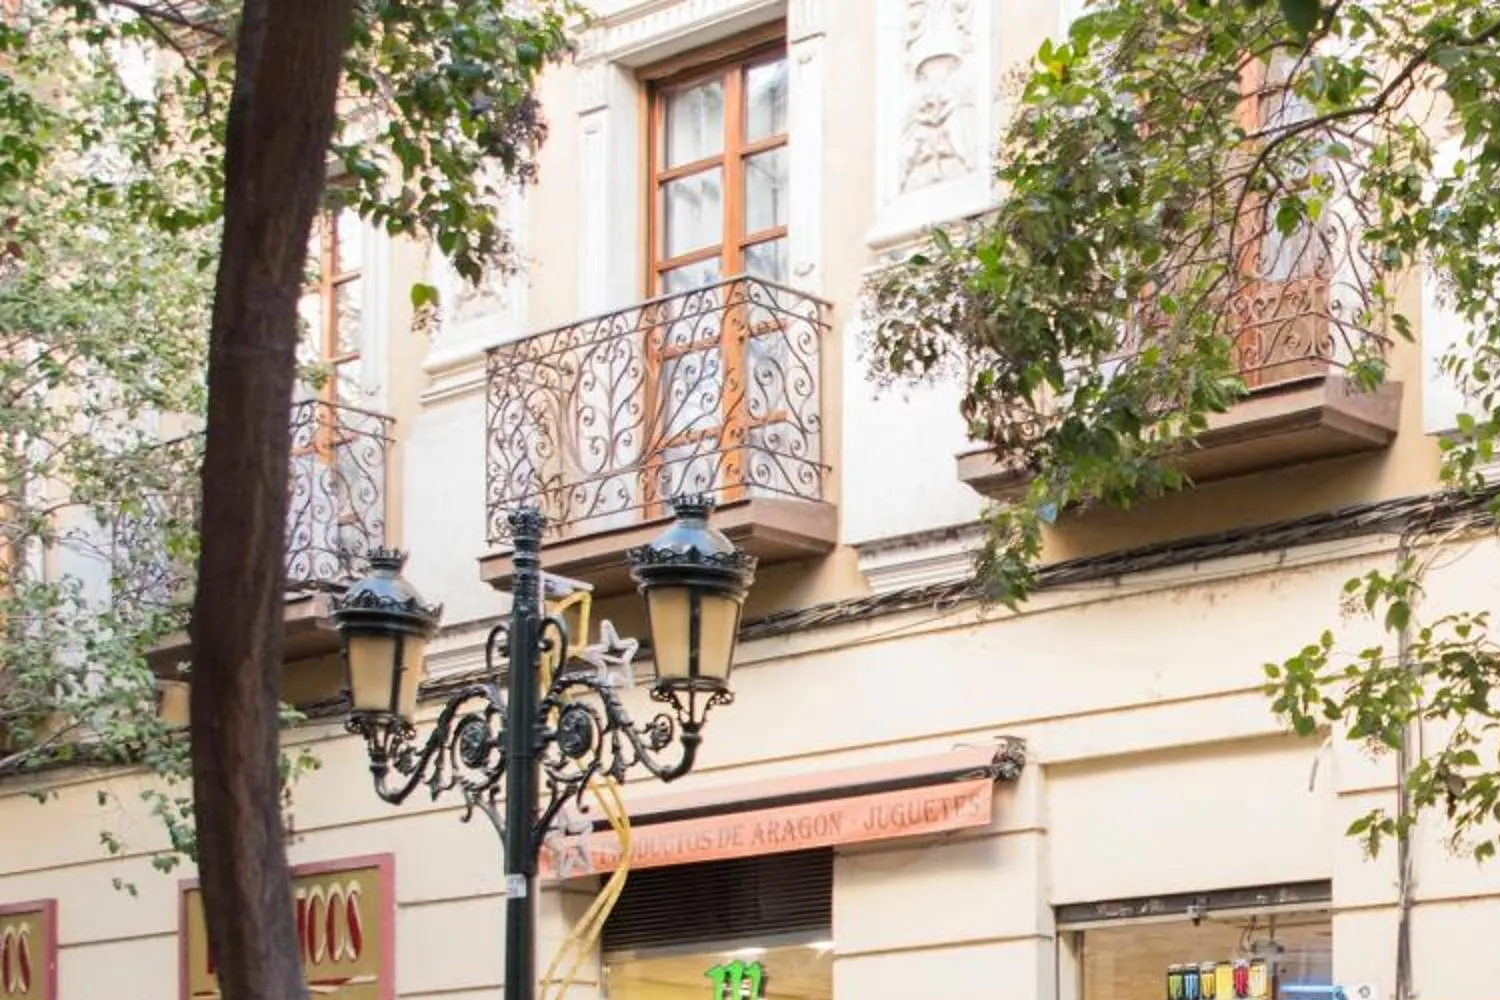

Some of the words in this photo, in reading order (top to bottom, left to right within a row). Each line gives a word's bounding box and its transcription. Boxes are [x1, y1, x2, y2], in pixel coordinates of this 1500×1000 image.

[600, 831, 711, 867] PRDUCTOS
[717, 825, 744, 850] DE
[751, 811, 843, 846] ARAGON
